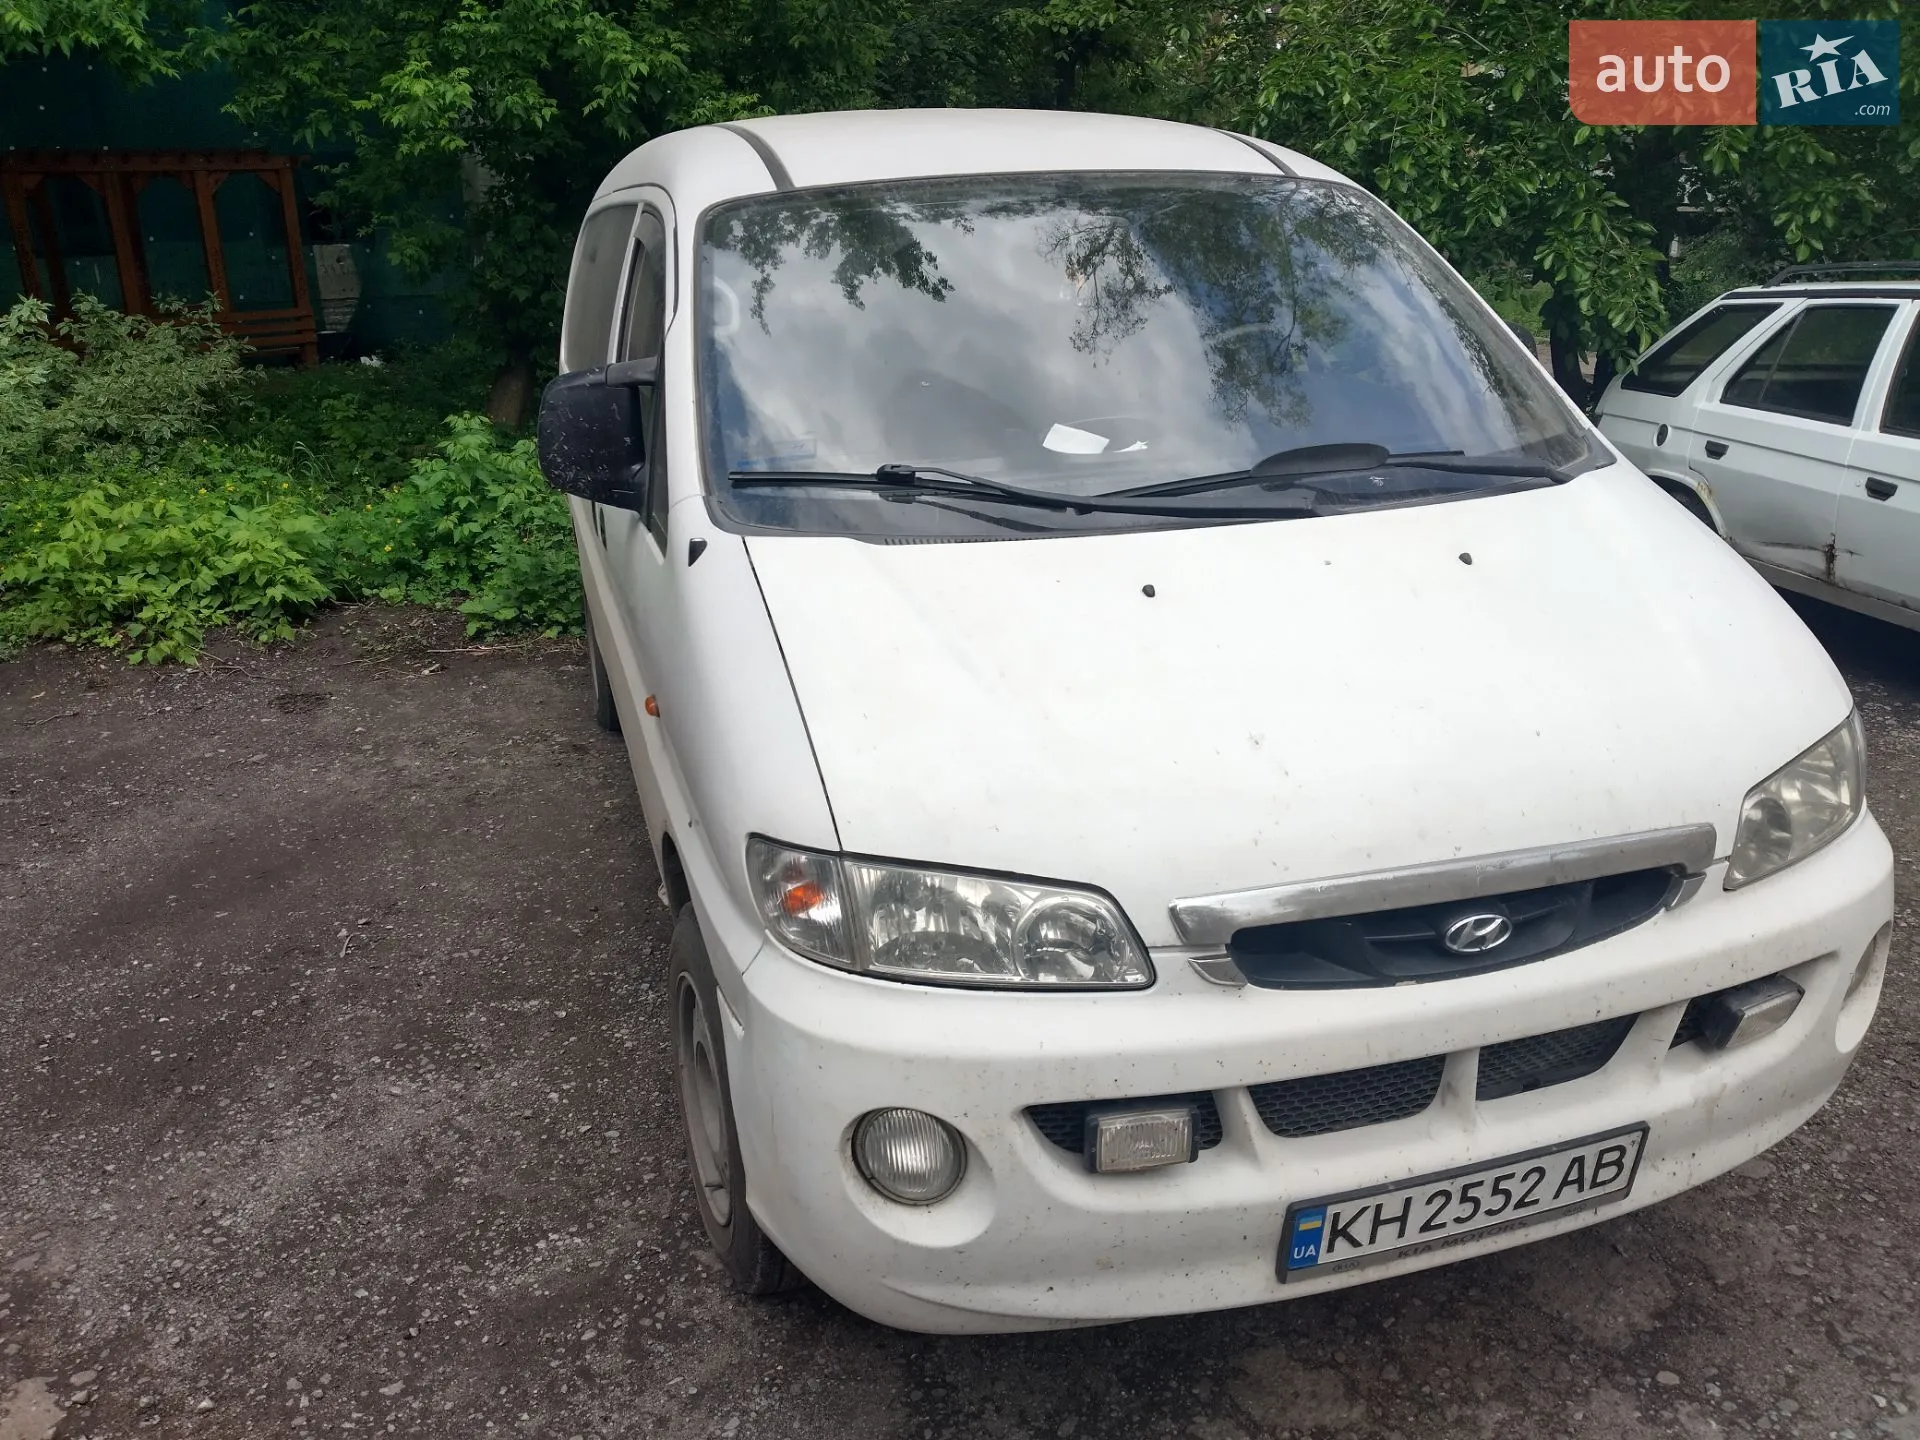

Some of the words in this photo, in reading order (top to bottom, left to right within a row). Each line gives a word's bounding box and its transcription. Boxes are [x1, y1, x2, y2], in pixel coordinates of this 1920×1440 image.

[1326, 1197, 1413, 1254] KH
[1419, 1166, 1545, 1233] 2552
[1552, 1145, 1627, 1200] AB
[1293, 1244, 1316, 1259] UA
[1398, 1245, 1432, 1258] KIA
